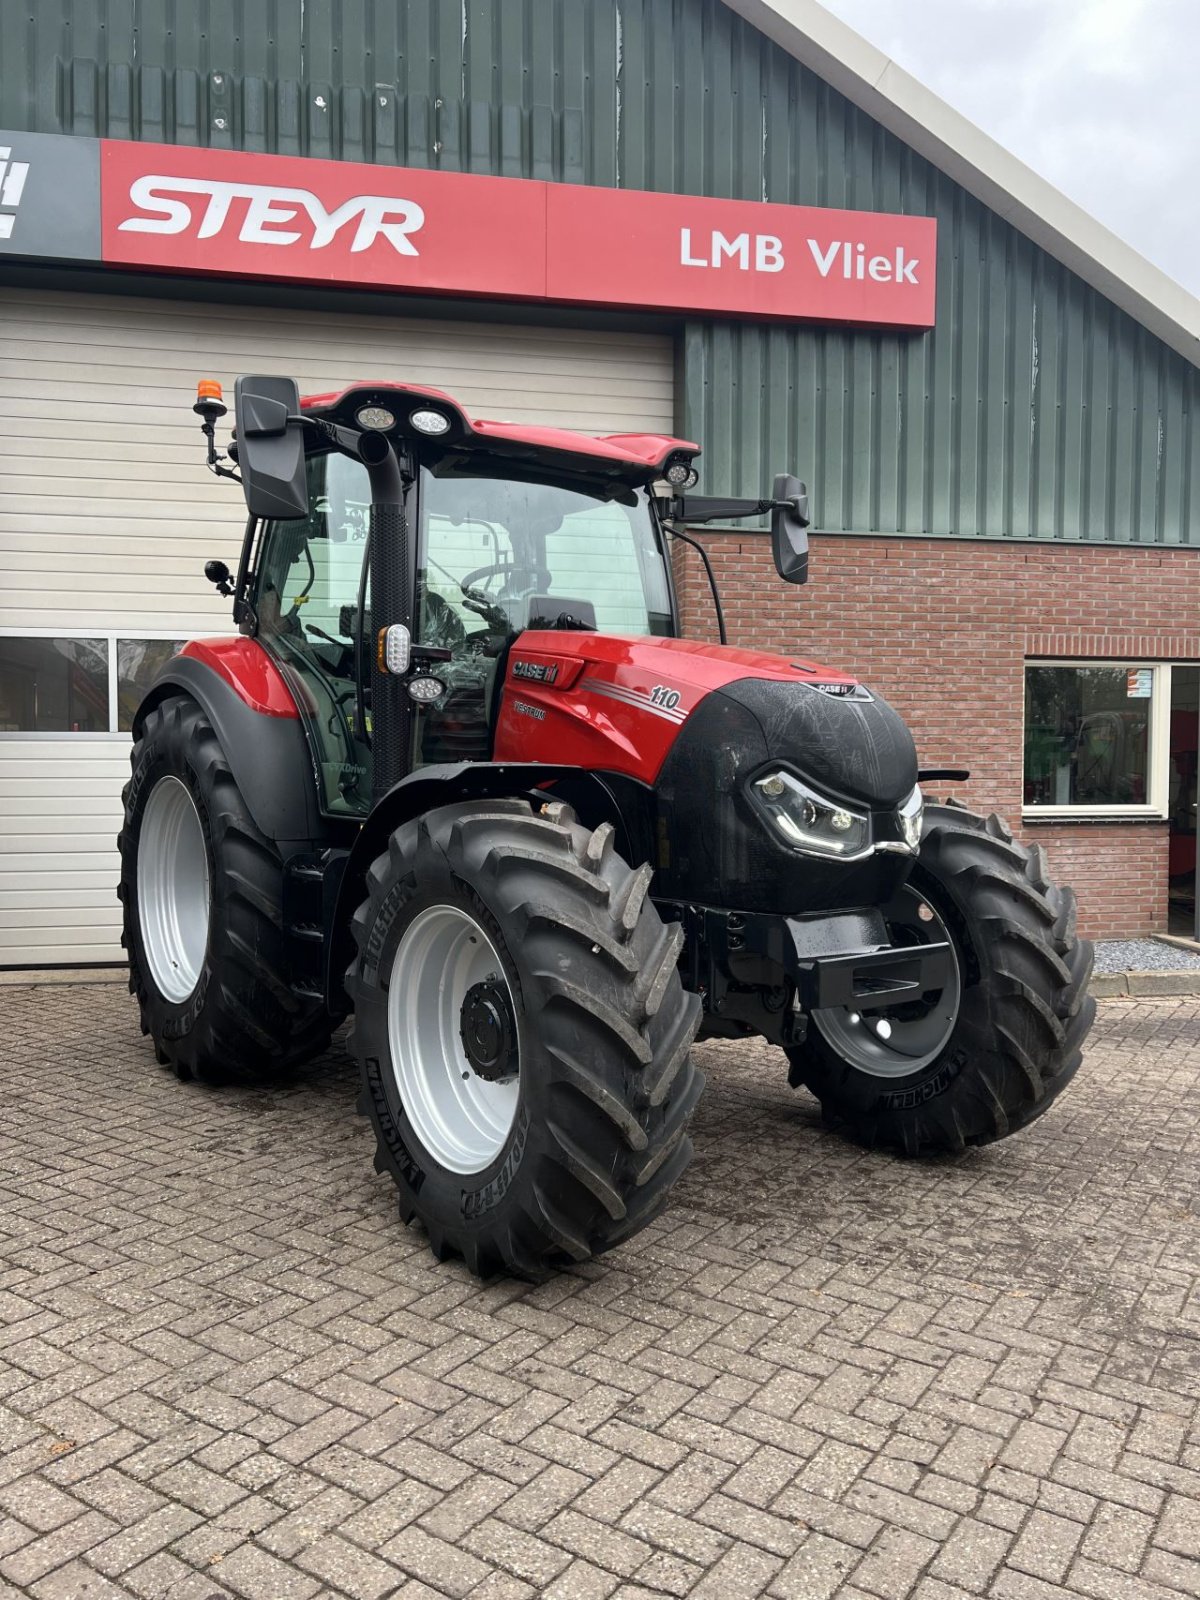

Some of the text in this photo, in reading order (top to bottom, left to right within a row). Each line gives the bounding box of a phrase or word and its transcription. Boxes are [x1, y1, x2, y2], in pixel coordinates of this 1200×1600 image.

[117, 174, 426, 257] STEYR
[680, 227, 920, 284] LMB Vliek
[512, 661, 545, 678] CASE
[650, 685, 681, 709] 110
